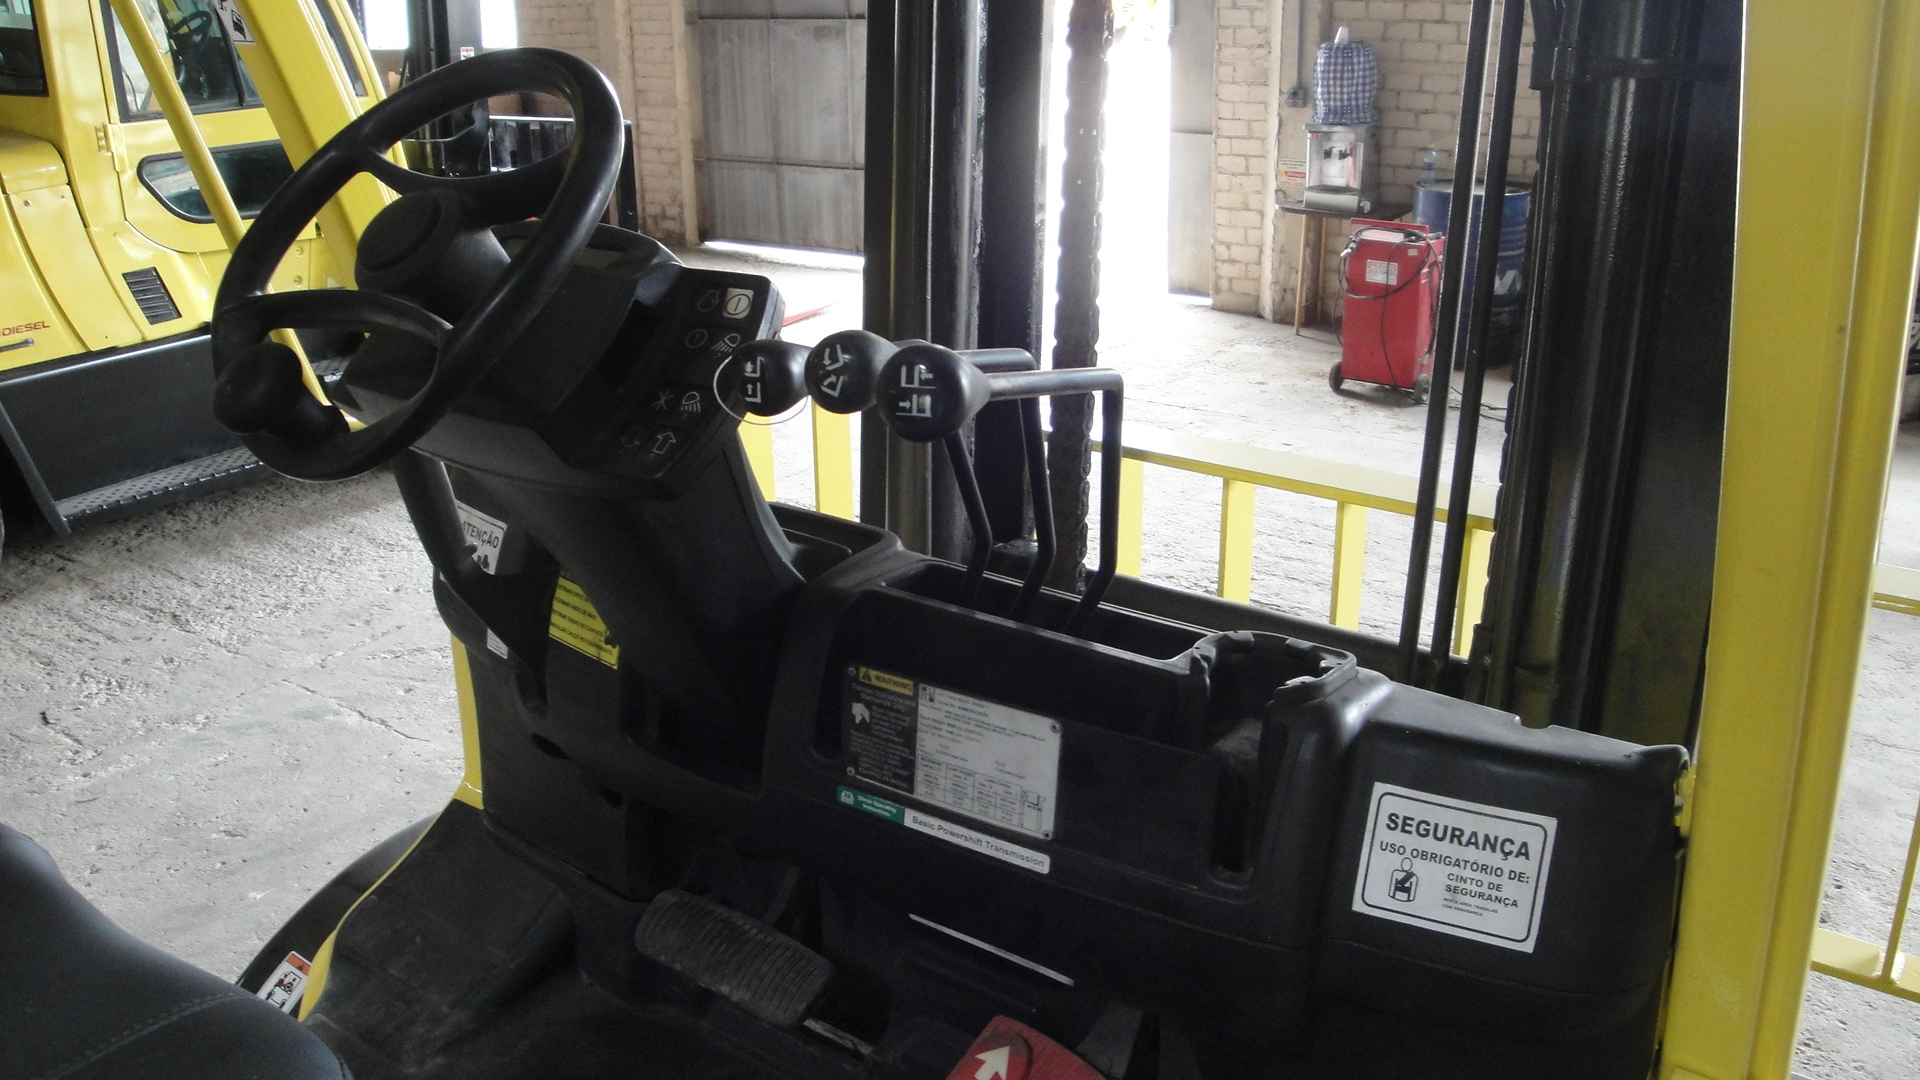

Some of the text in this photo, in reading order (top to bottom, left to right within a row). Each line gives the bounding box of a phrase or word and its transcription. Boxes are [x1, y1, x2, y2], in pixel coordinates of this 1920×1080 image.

[2, 320, 51, 337] DIESEL
[874, 674, 912, 692] WARNING
[911, 815, 1045, 868] Basic Powershift Transmission
[1385, 812, 1531, 861] SEGURANÇA
[1379, 840, 1530, 884] USO OBRIGATÓRIO DE:
[1447, 872, 1503, 893] CINTO DE
[1445, 883, 1519, 908] SEGURANÇA
